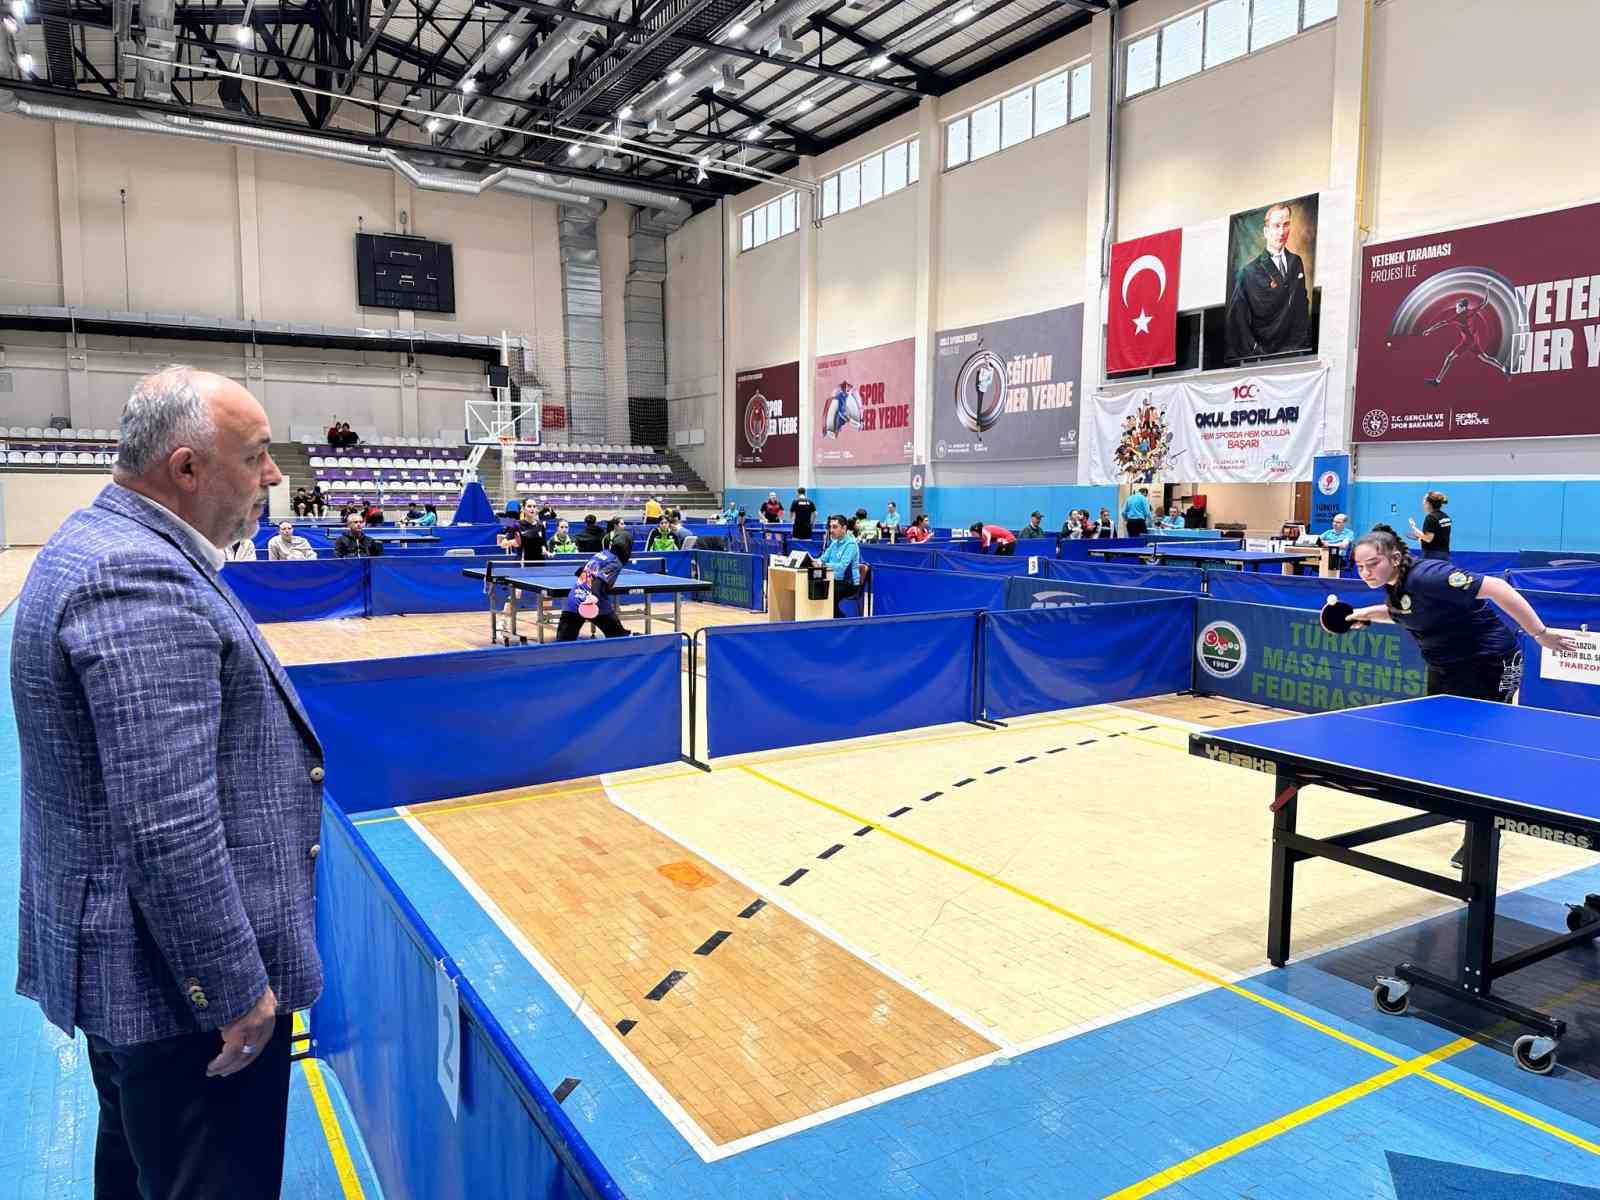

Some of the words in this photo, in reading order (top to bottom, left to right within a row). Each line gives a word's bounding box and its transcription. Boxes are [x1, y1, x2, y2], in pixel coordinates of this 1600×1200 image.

[1371, 251, 1405, 268] YETENEK
[1406, 243, 1452, 262] TARAMASI
[1371, 265, 1403, 283] PROJESİ
[1405, 263, 1417, 279] İLE
[1510, 328, 1574, 374] HER
[860, 382, 885, 406] SPOR
[1032, 381, 1073, 411] YERDE
[778, 416, 798, 435] YERDE
[879, 404, 909, 430] YERDE
[1195, 411, 1229, 429] OKUL
[1230, 406, 1299, 427] SPORLARI
[1215, 431, 1242, 439] SPORDA
[1261, 428, 1290, 437] OKULDA
[1227, 440, 1260, 450] BAŞARI
[1567, 640, 1597, 650] ABZON
[1263, 646, 1332, 681] MASA
[1205, 743, 1277, 775] Yasaka
[1494, 816, 1591, 848] PROGRESS
